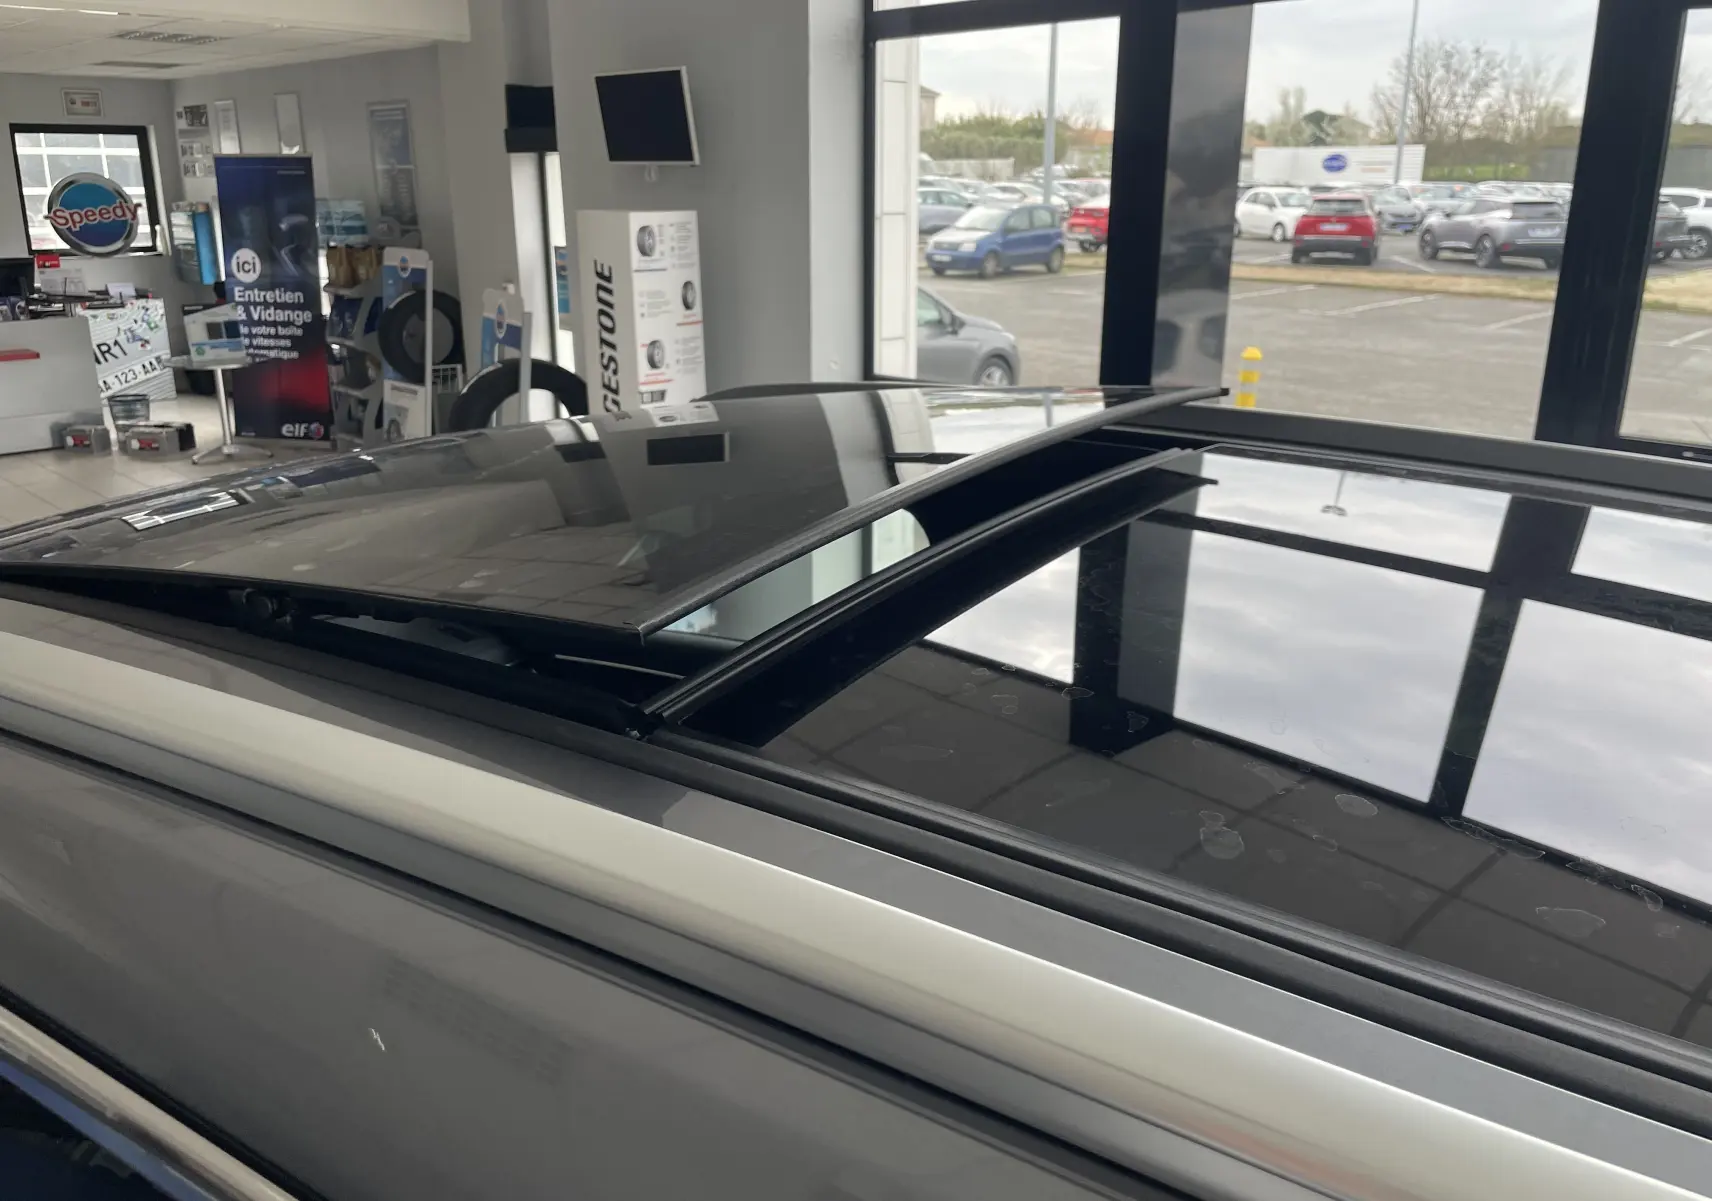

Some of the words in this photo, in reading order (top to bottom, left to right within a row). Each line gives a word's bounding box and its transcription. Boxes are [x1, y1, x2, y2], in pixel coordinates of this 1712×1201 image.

[44, 199, 142, 230] Speedy
[236, 256, 256, 273] ici
[234, 286, 304, 303] Entretien
[249, 305, 313, 326] Vidange
[251, 325, 277, 336] votre
[252, 337, 292, 348] vitesses
[282, 422, 309, 438] elf
